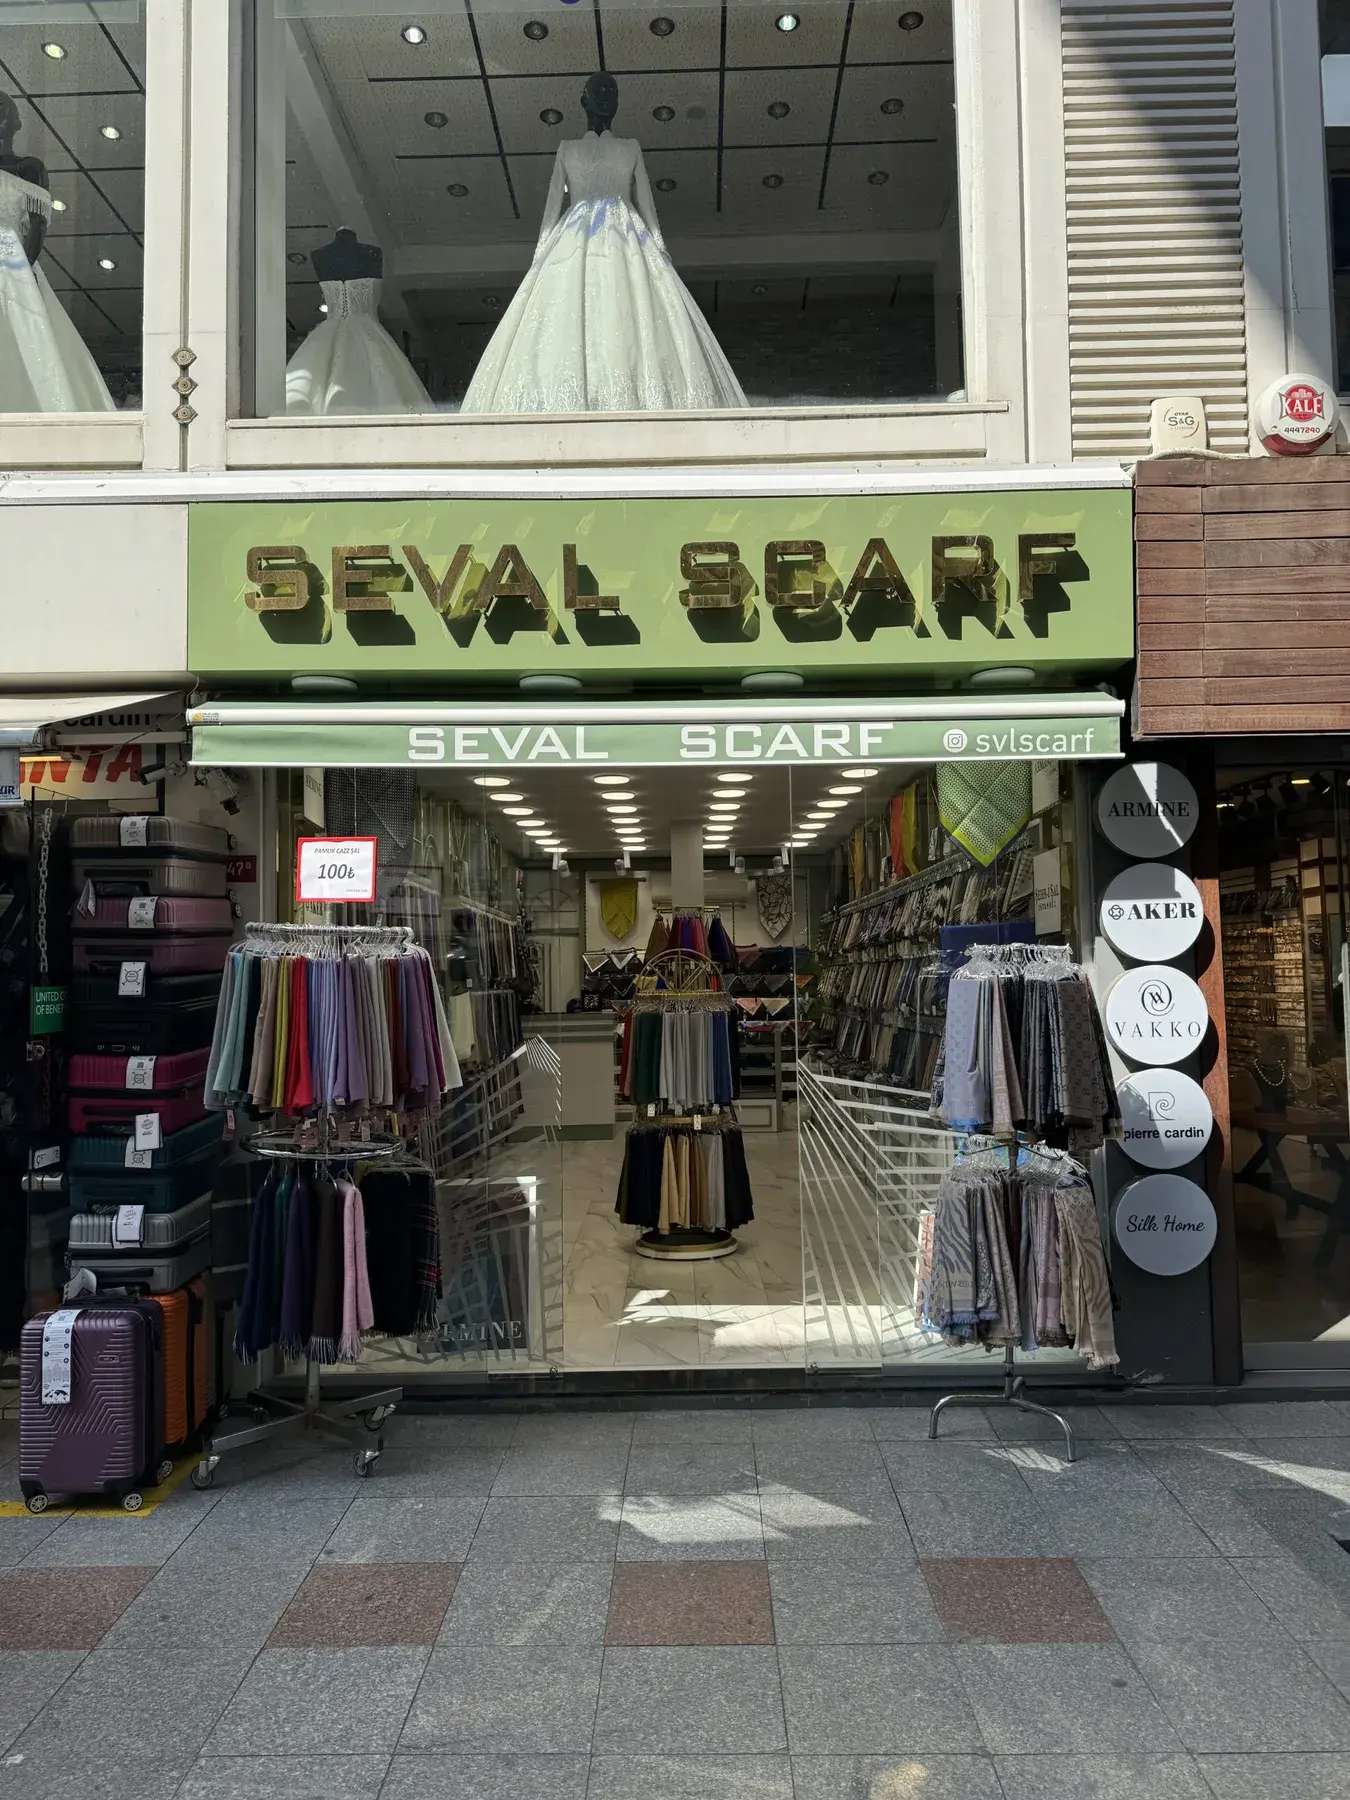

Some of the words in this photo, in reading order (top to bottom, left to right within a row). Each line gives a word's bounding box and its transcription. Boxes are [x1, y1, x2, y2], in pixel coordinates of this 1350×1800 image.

[1281, 395, 1323, 417] KALE
[1167, 415, 1195, 427] S&G
[244, 543, 621, 613] SEVAL
[678, 532, 1077, 610] SCARF
[408, 726, 609, 760] SEVAL
[679, 722, 894, 758] SCARF
[975, 727, 1095, 753] svlscarf
[1127, 902, 1197, 920] AKER
[35, 991, 59, 1002] UNITED
[35, 1004, 45, 1015] OF
[1115, 1021, 1201, 1038] VAKKO
[1123, 1127, 1160, 1141] pierre
[1164, 1126, 1204, 1138] cardin
[1126, 1214, 1159, 1233] Silk
[1163, 1214, 1206, 1233] Home
